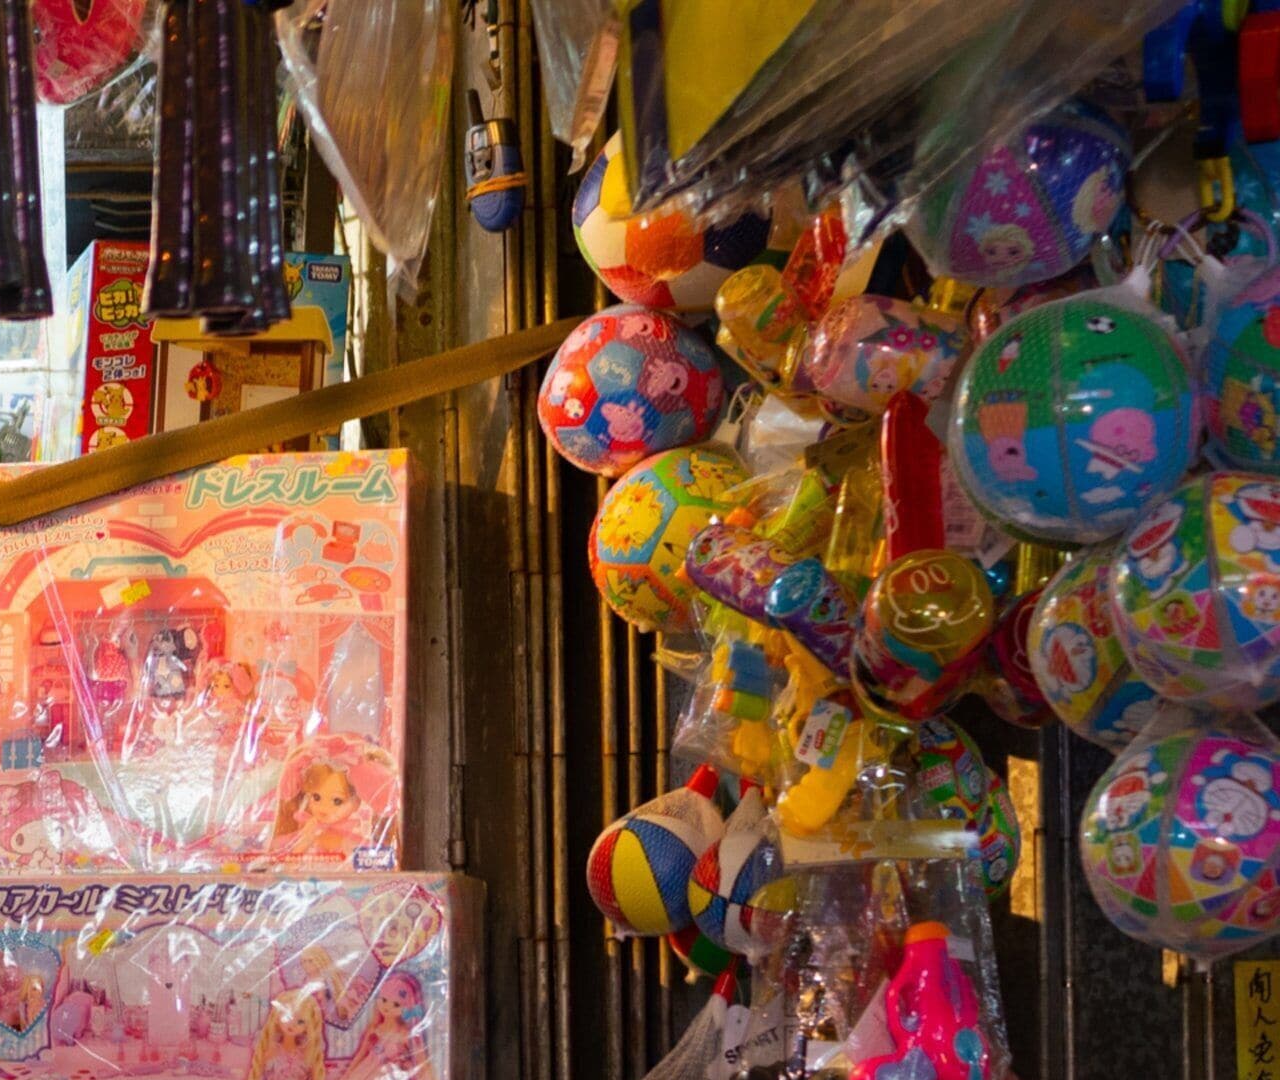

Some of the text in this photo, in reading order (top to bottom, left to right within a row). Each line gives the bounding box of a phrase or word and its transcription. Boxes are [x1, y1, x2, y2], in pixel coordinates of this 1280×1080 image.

[187, 466, 397, 507] ドレスルーム
